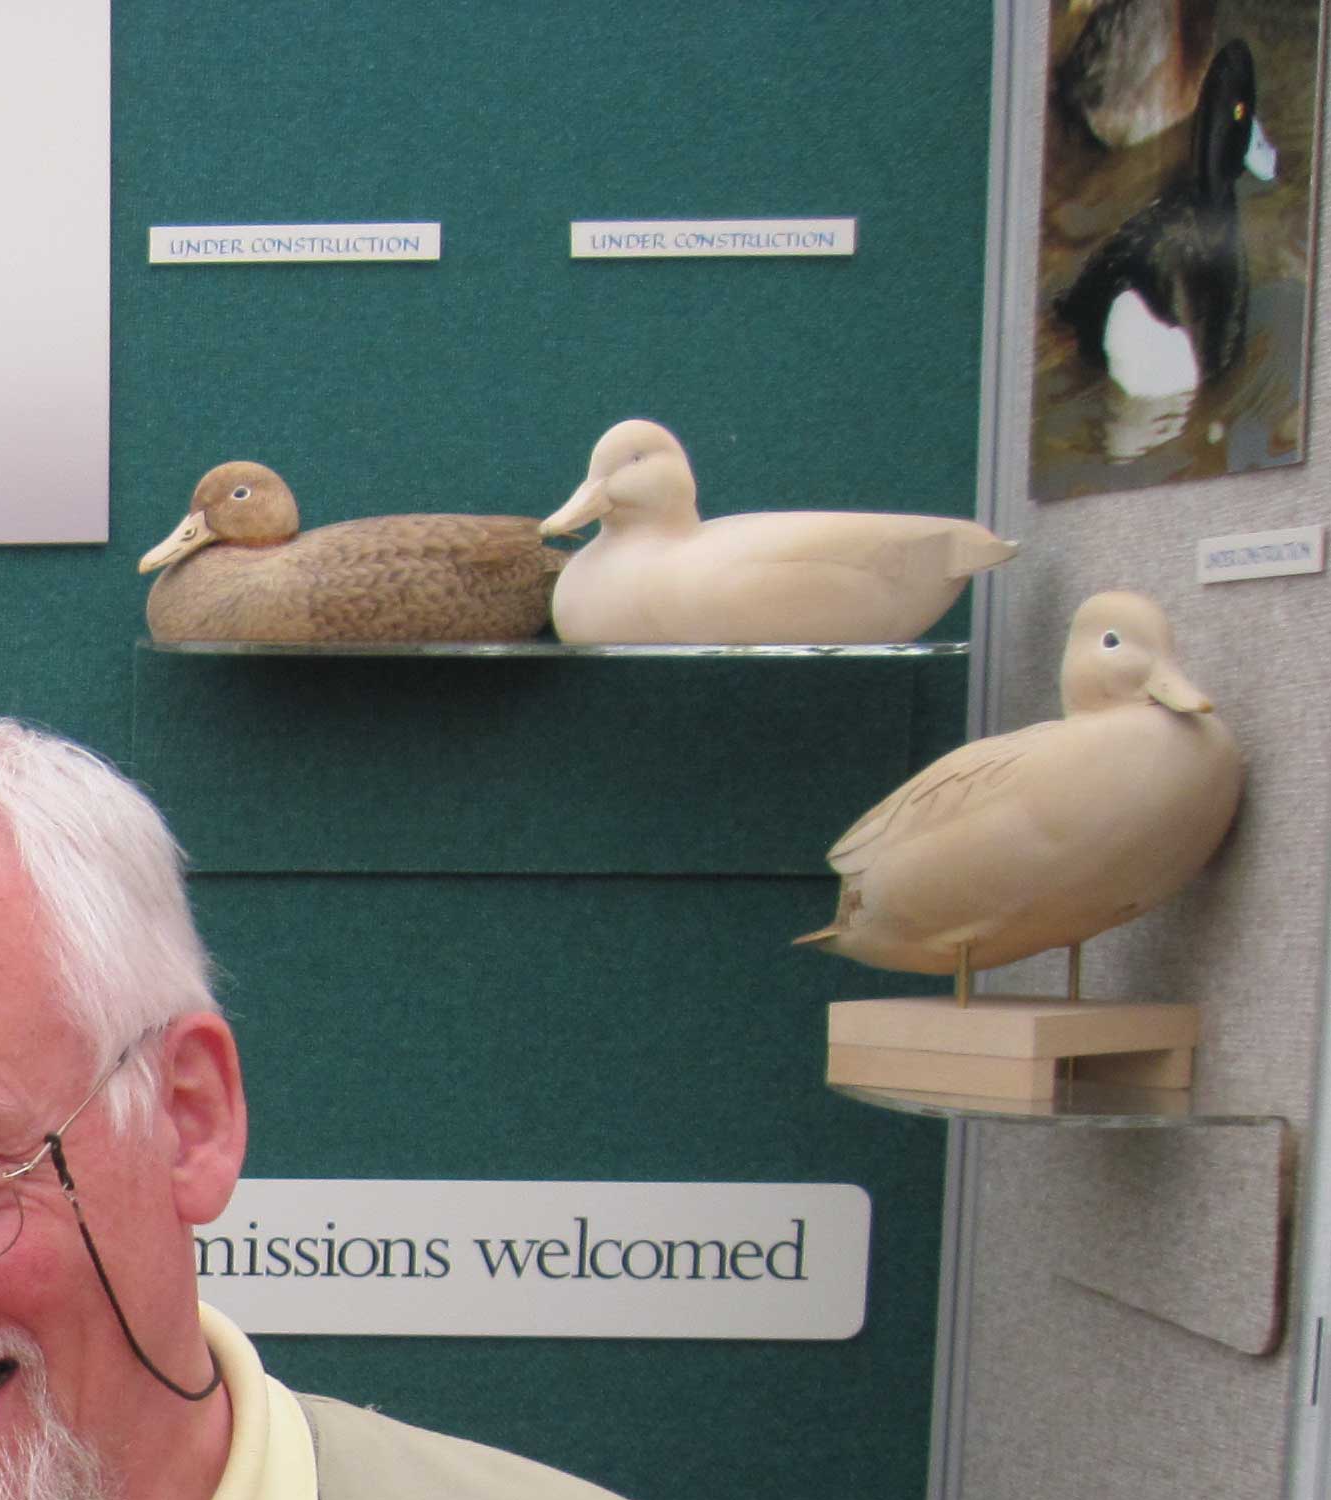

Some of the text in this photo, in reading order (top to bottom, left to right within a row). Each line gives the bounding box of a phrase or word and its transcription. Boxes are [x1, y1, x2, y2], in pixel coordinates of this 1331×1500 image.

[170, 235, 420, 257] UNDER CONSTRUCTION
[590, 231, 836, 251] UNDER CONSTRUCTION
[473, 1217, 809, 1281] welcomed
